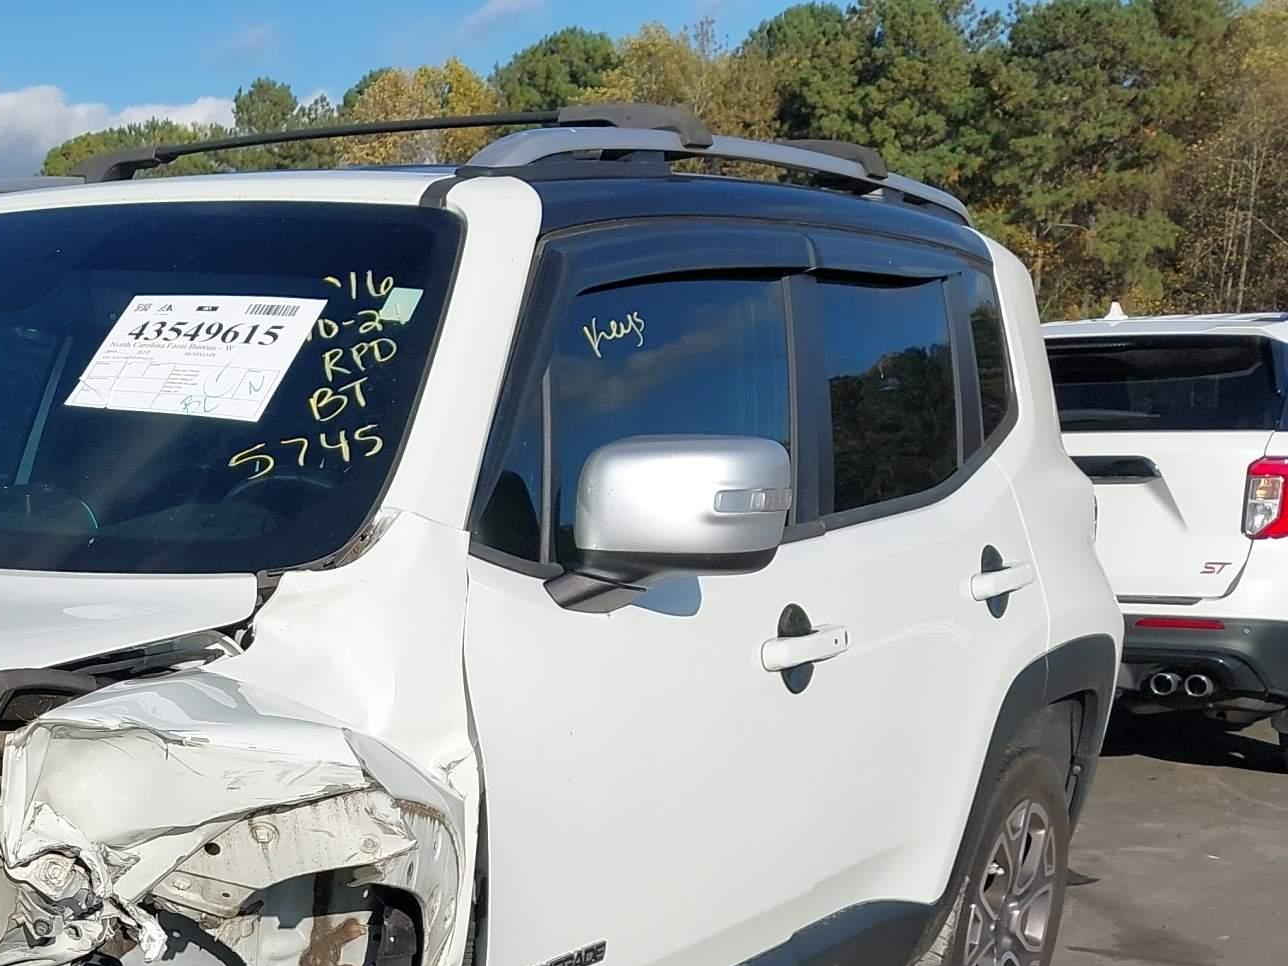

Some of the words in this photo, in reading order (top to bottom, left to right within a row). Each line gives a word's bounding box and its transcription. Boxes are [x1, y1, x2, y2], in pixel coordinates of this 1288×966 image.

[109, 341, 131, 349] North
[133, 341, 166, 350] Carolina
[166, 342, 187, 350] Farm
[188, 343, 217, 351] Bureau
[127, 320, 286, 346] 43549615
[583, 310, 646, 358] Keys
[322, 337, 398, 382] RPD
[308, 376, 369, 422] BT
[227, 423, 384, 480] 5745
[1199, 561, 1234, 575] ST
